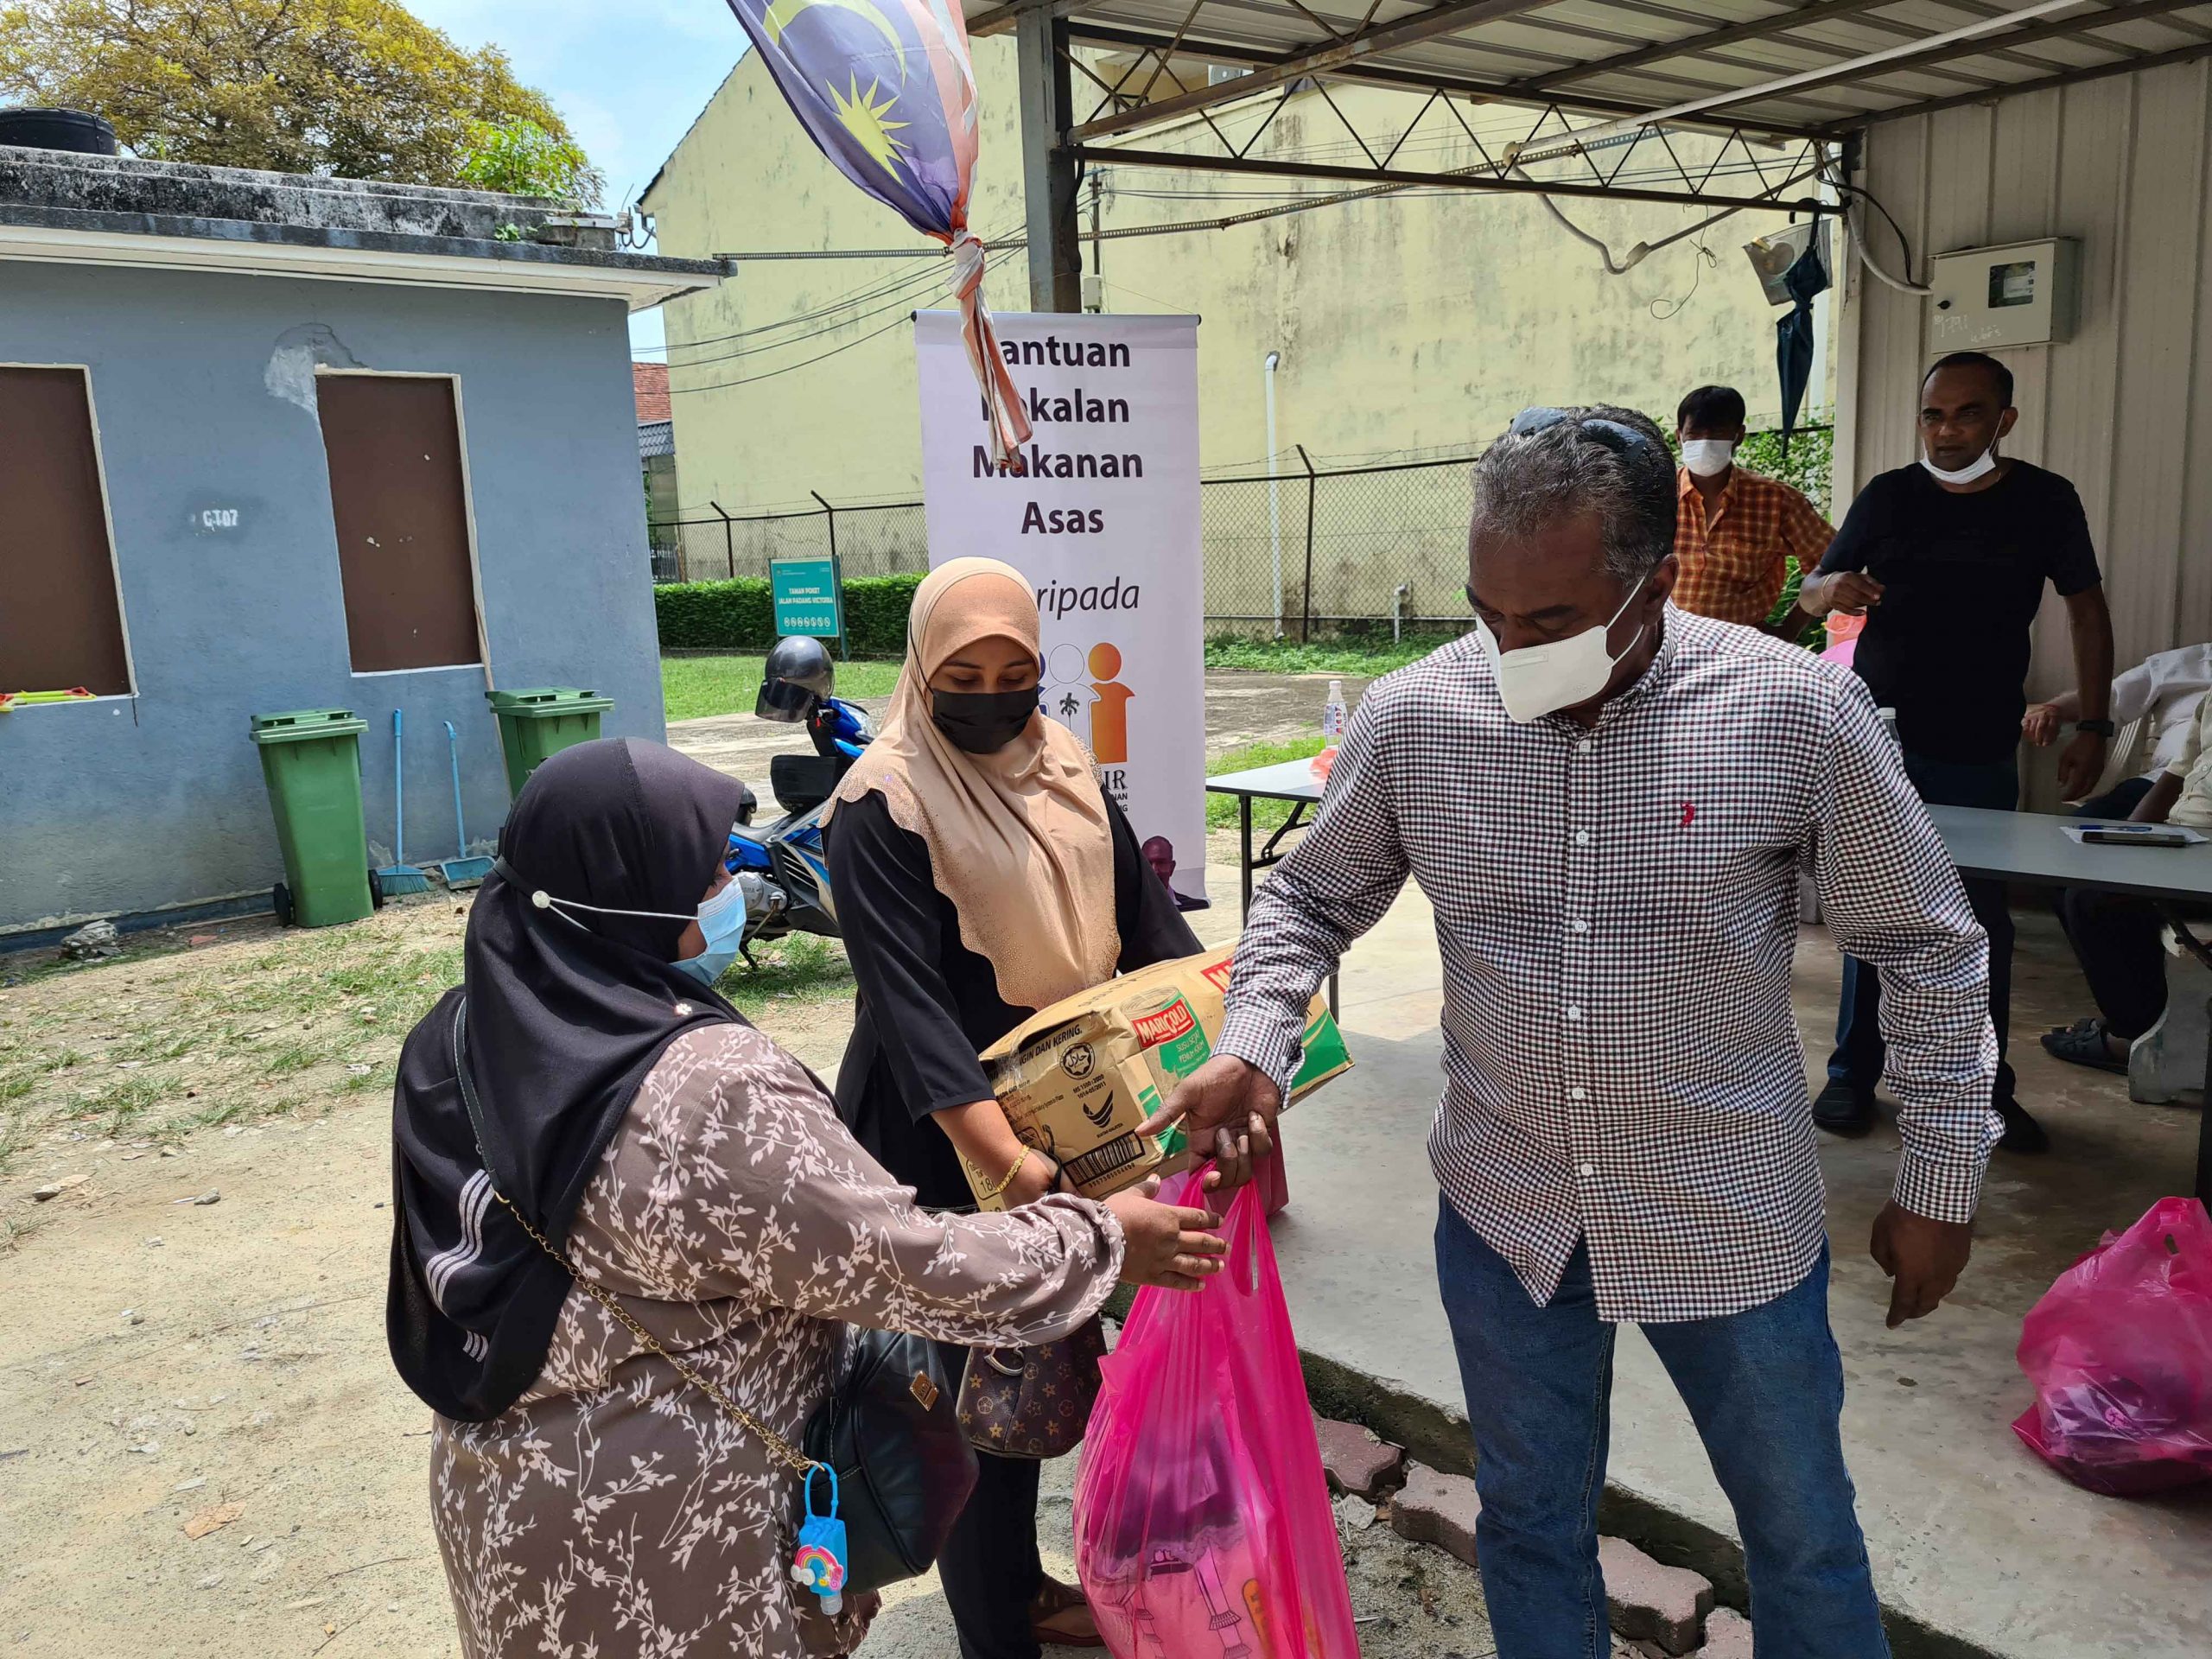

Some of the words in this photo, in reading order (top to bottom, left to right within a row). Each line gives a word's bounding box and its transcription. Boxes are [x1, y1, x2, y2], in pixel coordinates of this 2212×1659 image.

[1000, 335, 1130, 367] antuan
[981, 387, 1129, 423] kalan
[1020, 501, 1104, 534] Asas
[1037, 575, 1140, 620] ripada
[1035, 1040, 1052, 1057] DAN
[1053, 1024, 1083, 1046] KERING.
[1135, 1003, 1188, 1044] MARIGOLD
